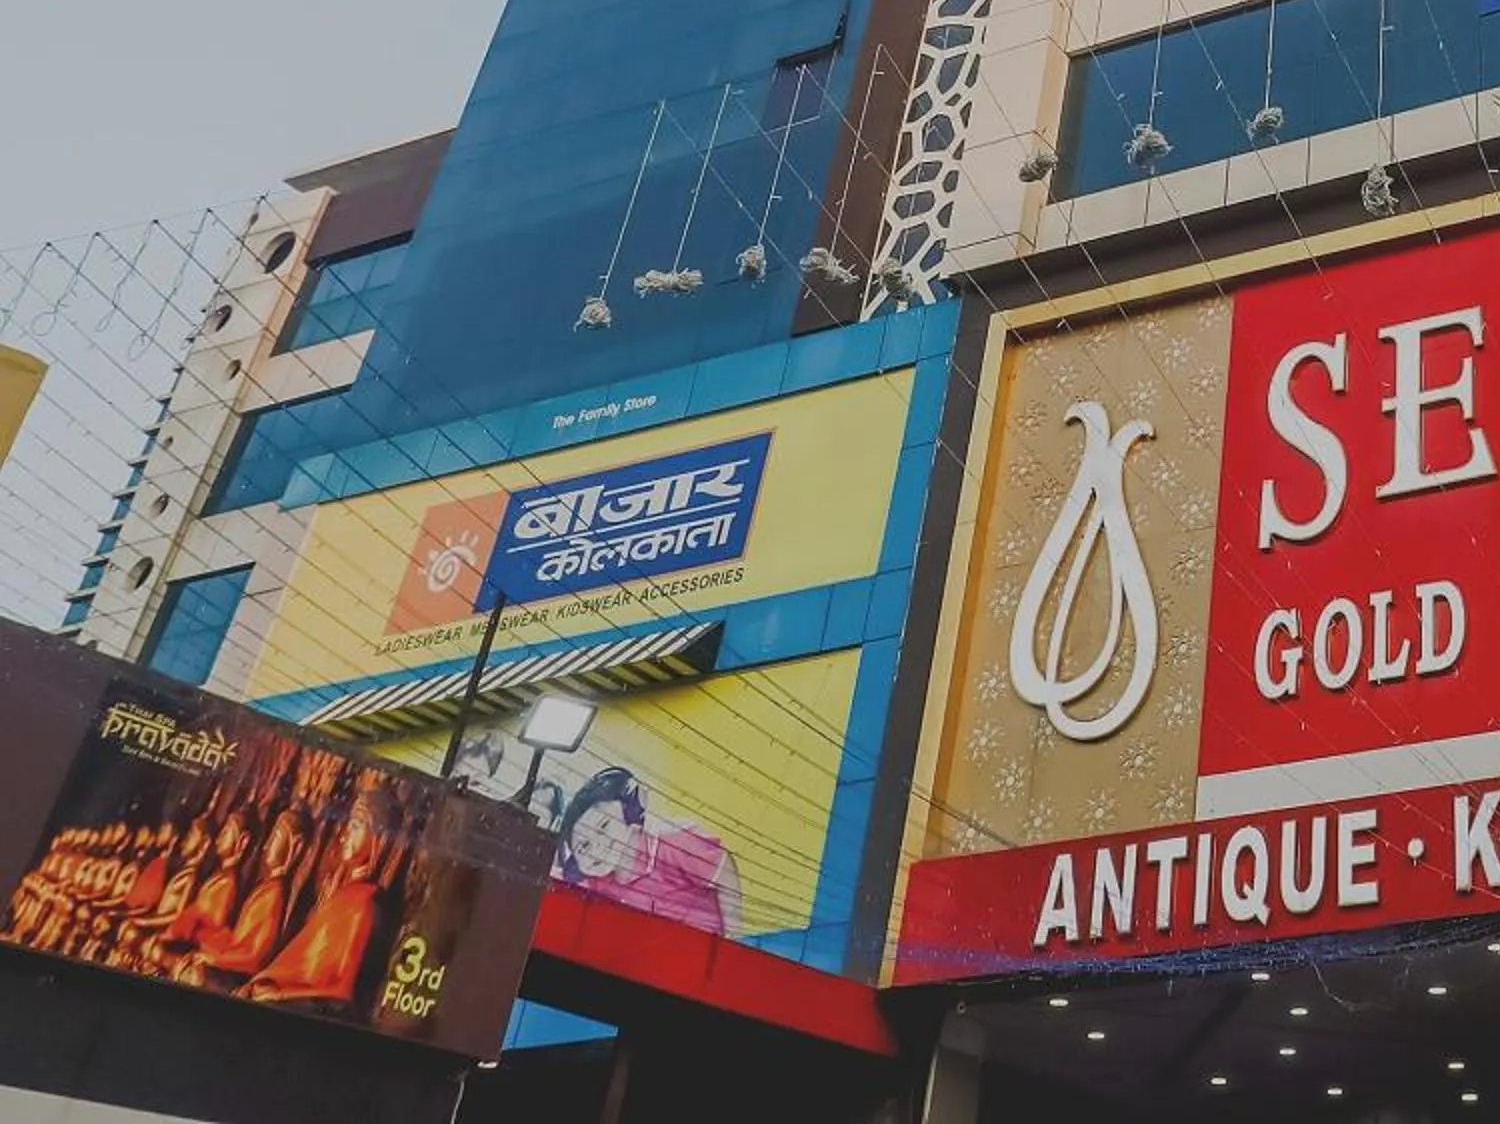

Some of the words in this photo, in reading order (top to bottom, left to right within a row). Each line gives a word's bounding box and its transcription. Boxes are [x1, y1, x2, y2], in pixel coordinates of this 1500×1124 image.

[553, 414, 575, 429] The
[578, 402, 621, 423] Family
[623, 395, 657, 413] Store
[513, 459, 750, 540] बाजार
[536, 512, 737, 582] कोलकाता
[374, 626, 463, 656] LADIESWEAR
[471, 608, 549, 638] MESWEAR
[555, 591, 632, 619] KIDSWEAR
[640, 567, 745, 601] ACCESSORIES
[1253, 580, 1466, 701] GOLD
[1032, 808, 1382, 948] ANTIQUE
[381, 981, 436, 1018] Floor
[395, 937, 446, 991] 3rd
